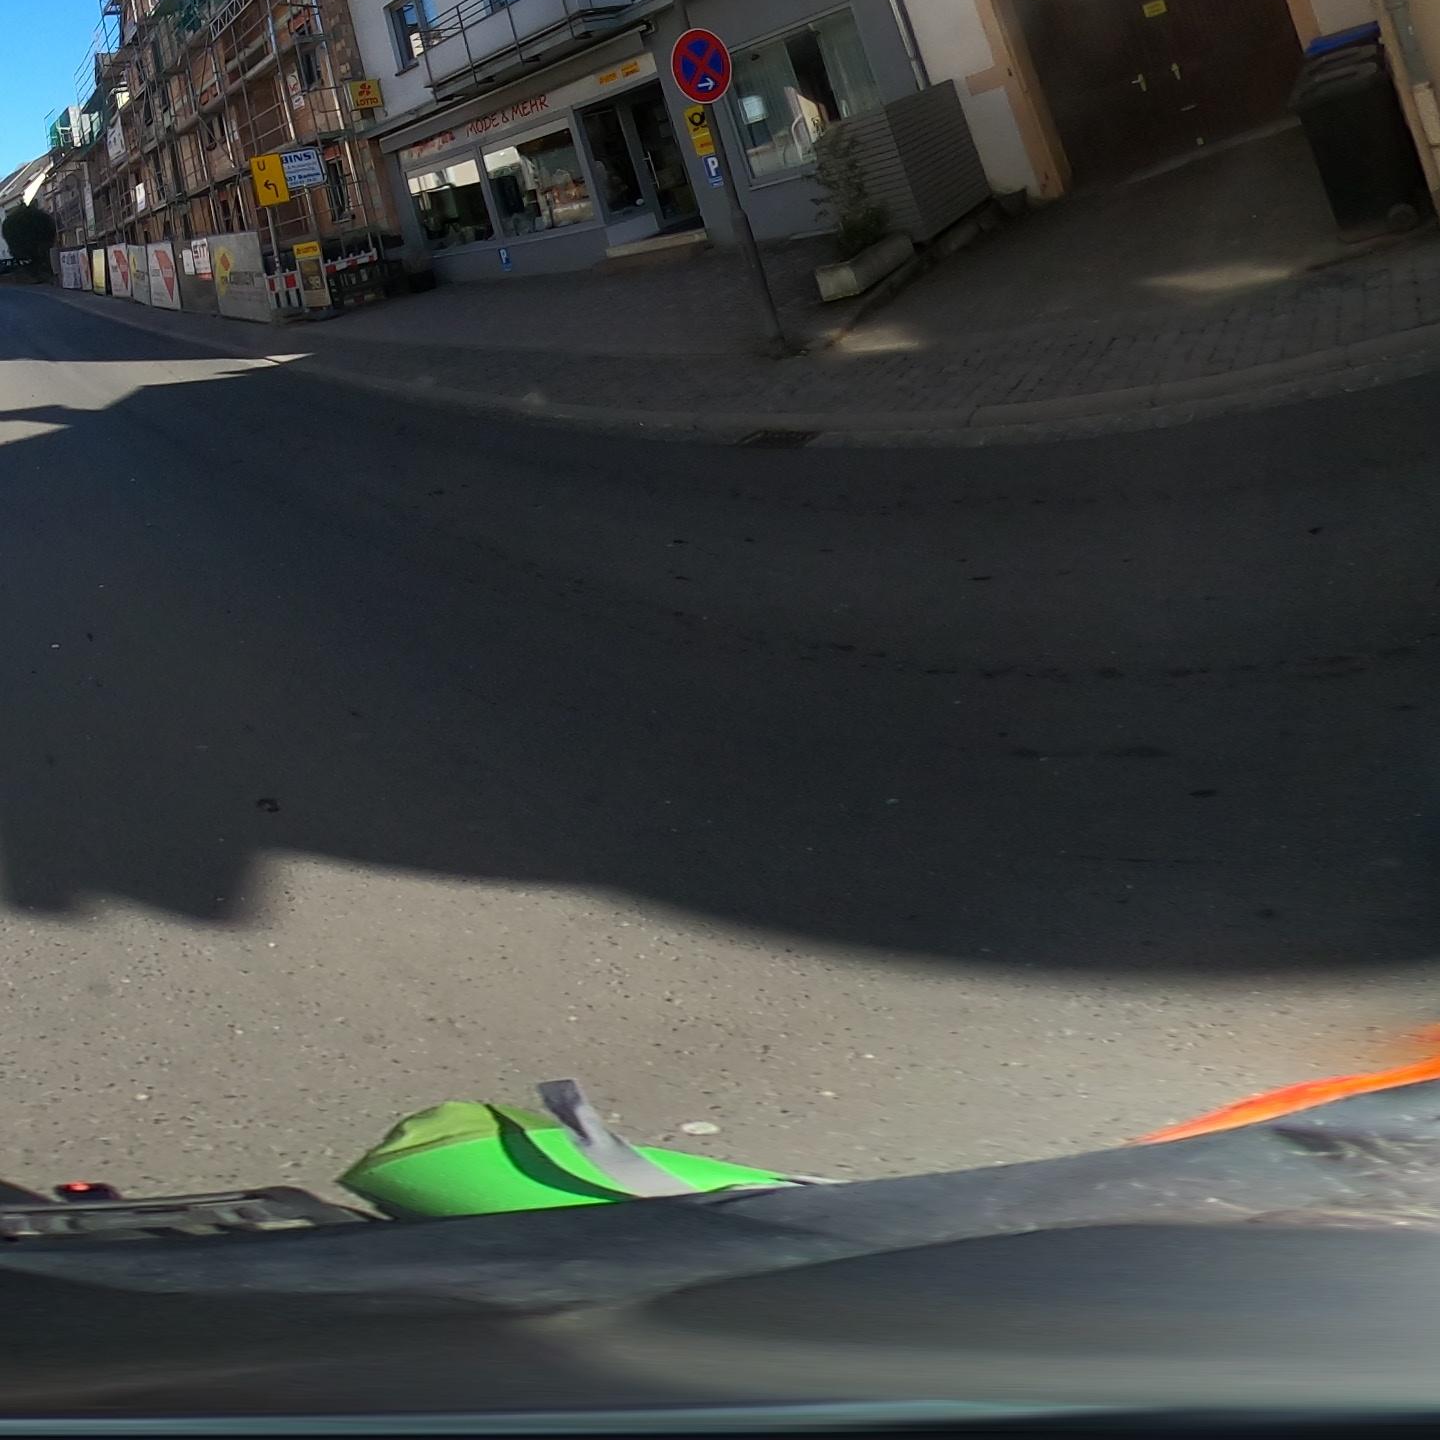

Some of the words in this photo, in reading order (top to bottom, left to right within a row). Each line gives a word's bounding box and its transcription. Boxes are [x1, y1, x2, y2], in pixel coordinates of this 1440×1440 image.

[356, 97, 379, 107] LOTTO
[466, 111, 500, 138] MODE
[500, 110, 509, 124] &
[511, 94, 550, 121] MEHR
[256, 159, 267, 172] U
[707, 156, 719, 177] P
